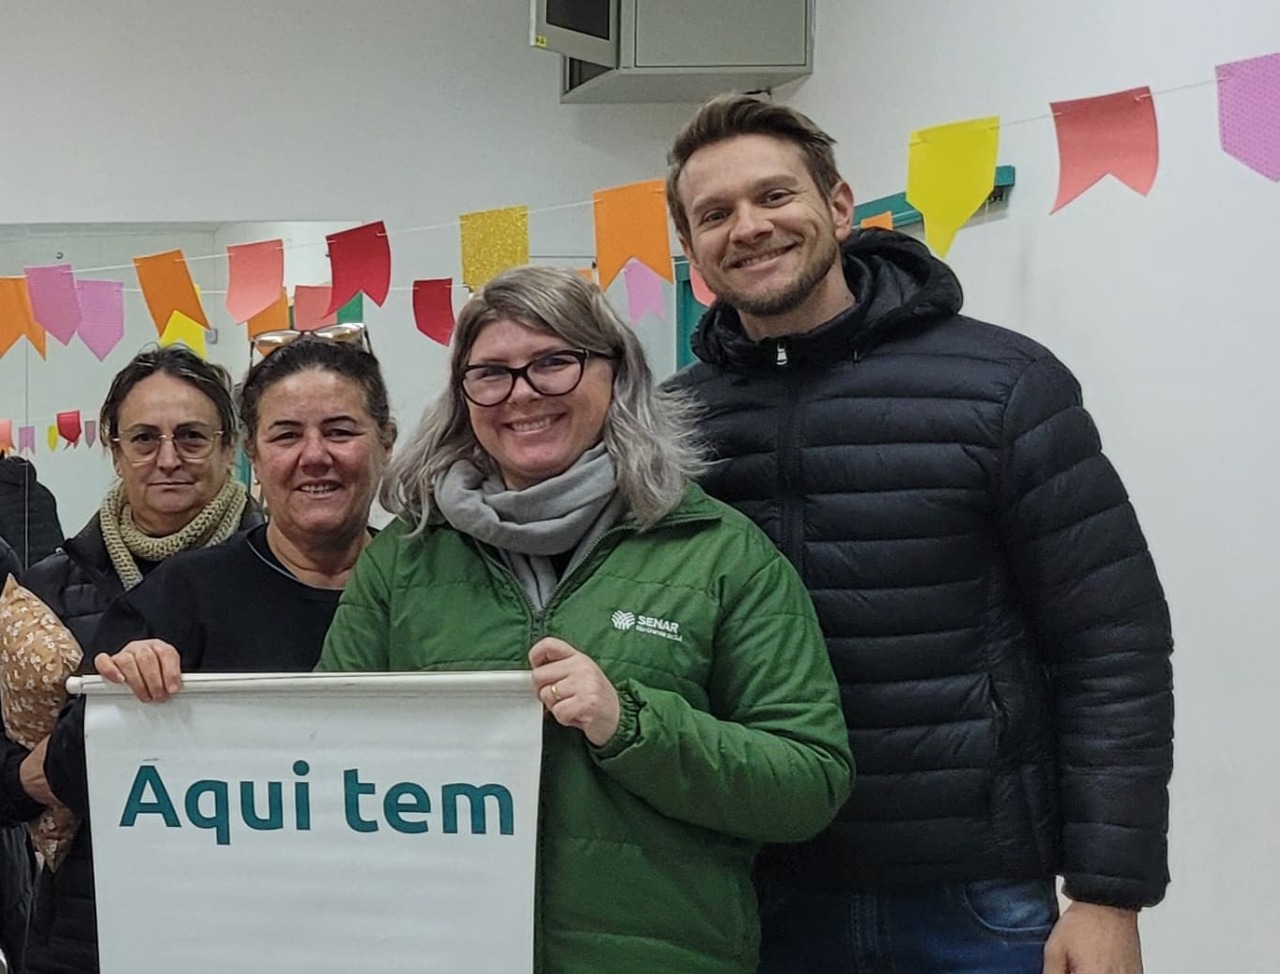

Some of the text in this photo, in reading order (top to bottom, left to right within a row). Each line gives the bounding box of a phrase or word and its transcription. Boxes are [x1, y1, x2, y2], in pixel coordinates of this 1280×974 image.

[637, 615, 679, 634] SENAR
[118, 759, 515, 846] Aqui tem
